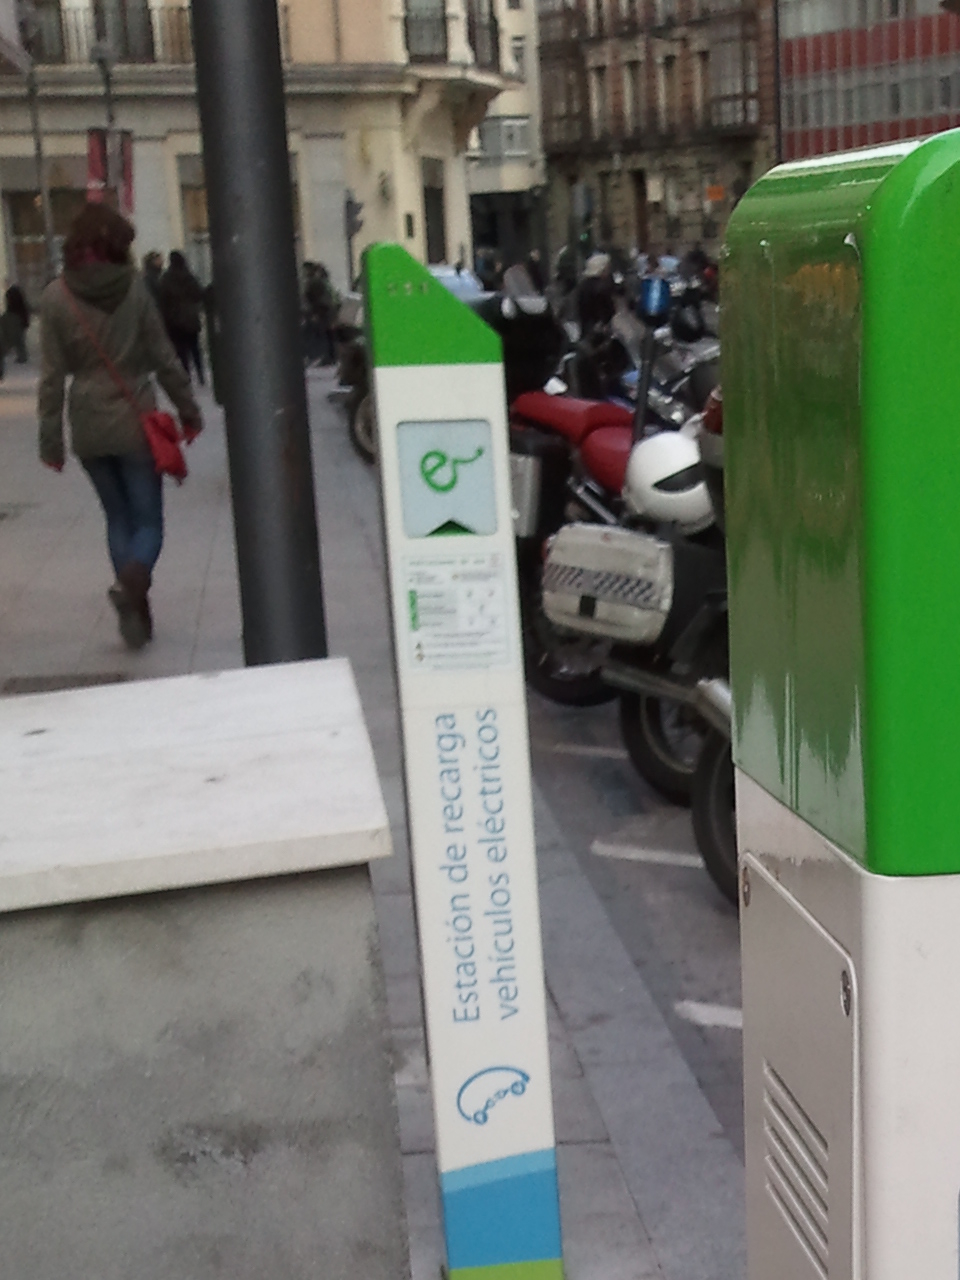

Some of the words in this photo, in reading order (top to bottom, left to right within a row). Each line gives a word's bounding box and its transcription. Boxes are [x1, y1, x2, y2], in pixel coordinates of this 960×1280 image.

[435, 712, 466, 835] recarga
[473, 706, 507, 864] eléctricos
[439, 845, 469, 885] de
[445, 893, 480, 1025] Estación
[484, 873, 519, 1021] vehículos
